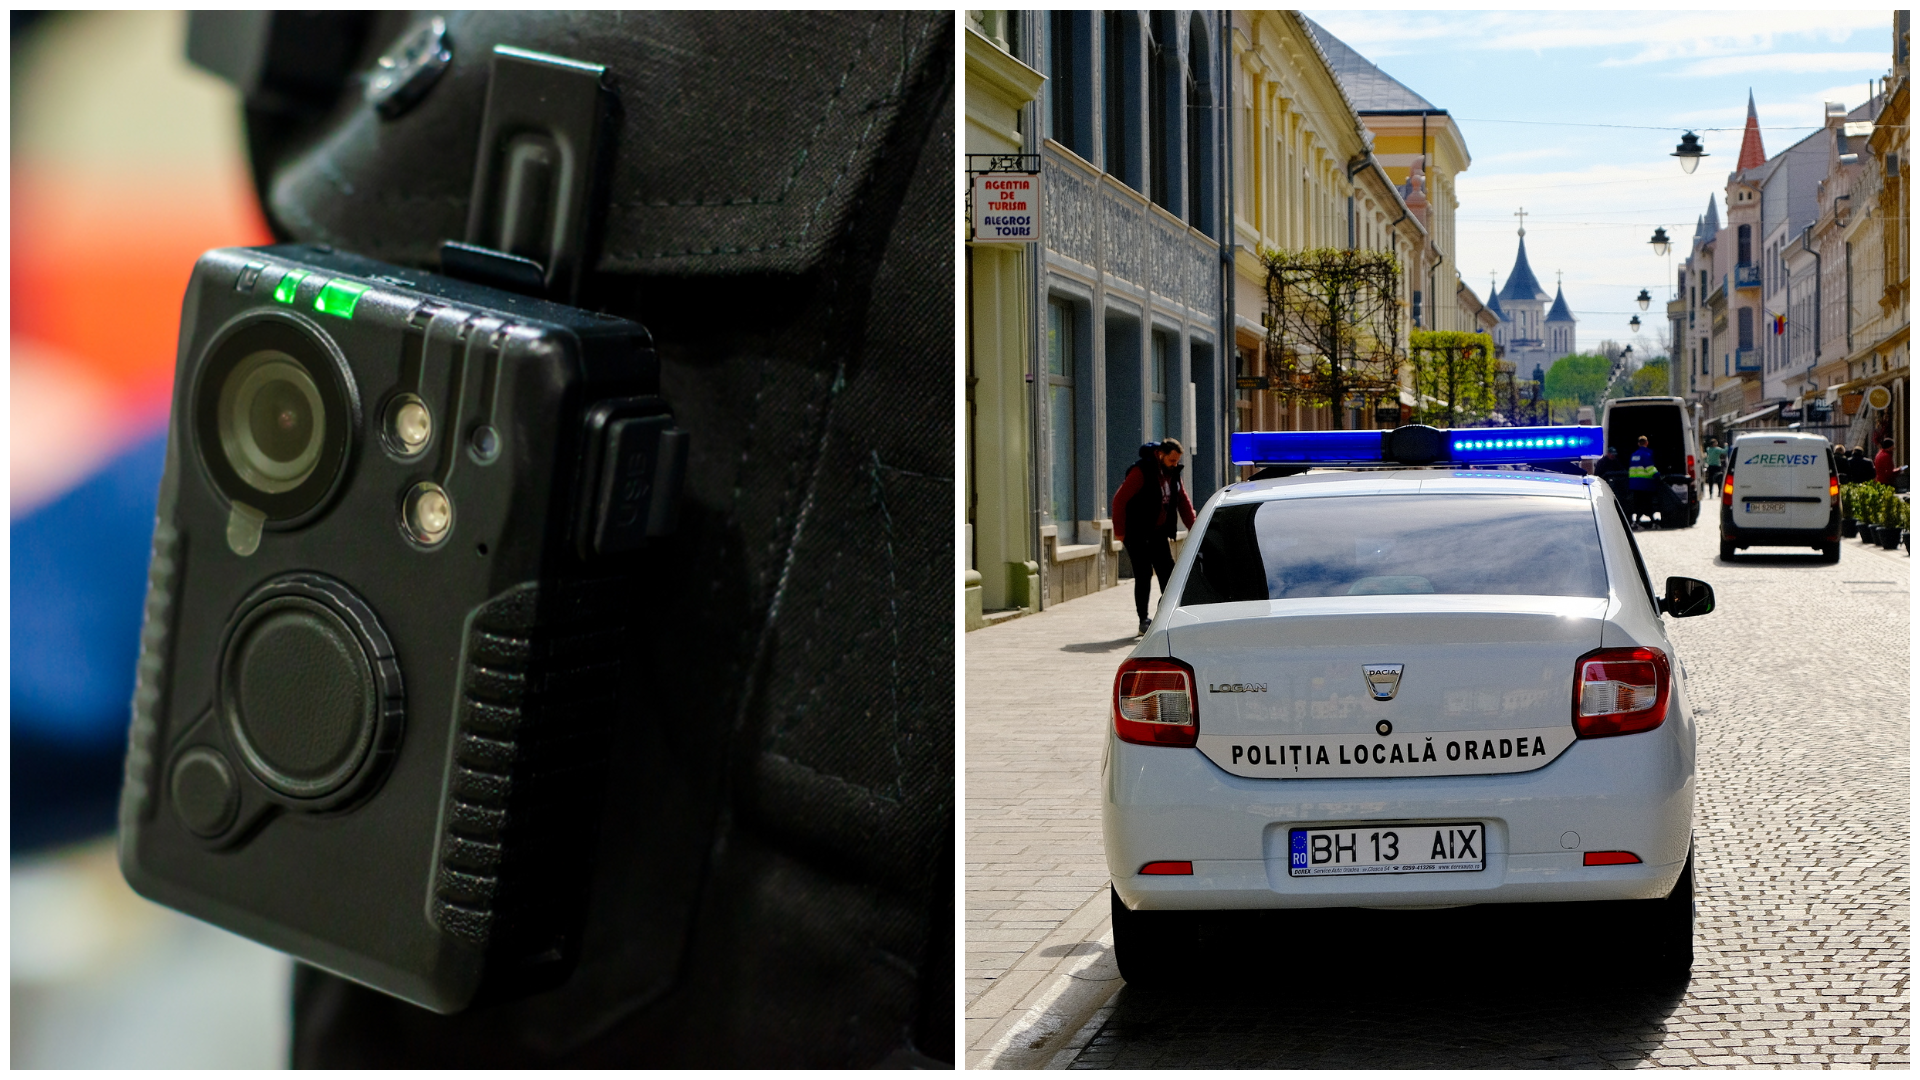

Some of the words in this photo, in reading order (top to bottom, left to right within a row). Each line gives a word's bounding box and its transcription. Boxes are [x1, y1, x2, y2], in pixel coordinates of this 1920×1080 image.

[985, 181, 1030, 190] AGENTIA
[1000, 191, 1015, 200] DE
[988, 202, 1027, 211] TURISM
[984, 216, 1031, 226] ALEGROS
[996, 227, 1031, 236] TOURS
[1209, 682, 1268, 694] LOGAN
[1339, 737, 1437, 765] LOCALĂ
[1446, 736, 1547, 761] ORADEA
[1311, 833, 1357, 864] BH
[1370, 831, 1399, 861] 13
[1430, 829, 1478, 860] AIX
[1293, 852, 1307, 865] RO
